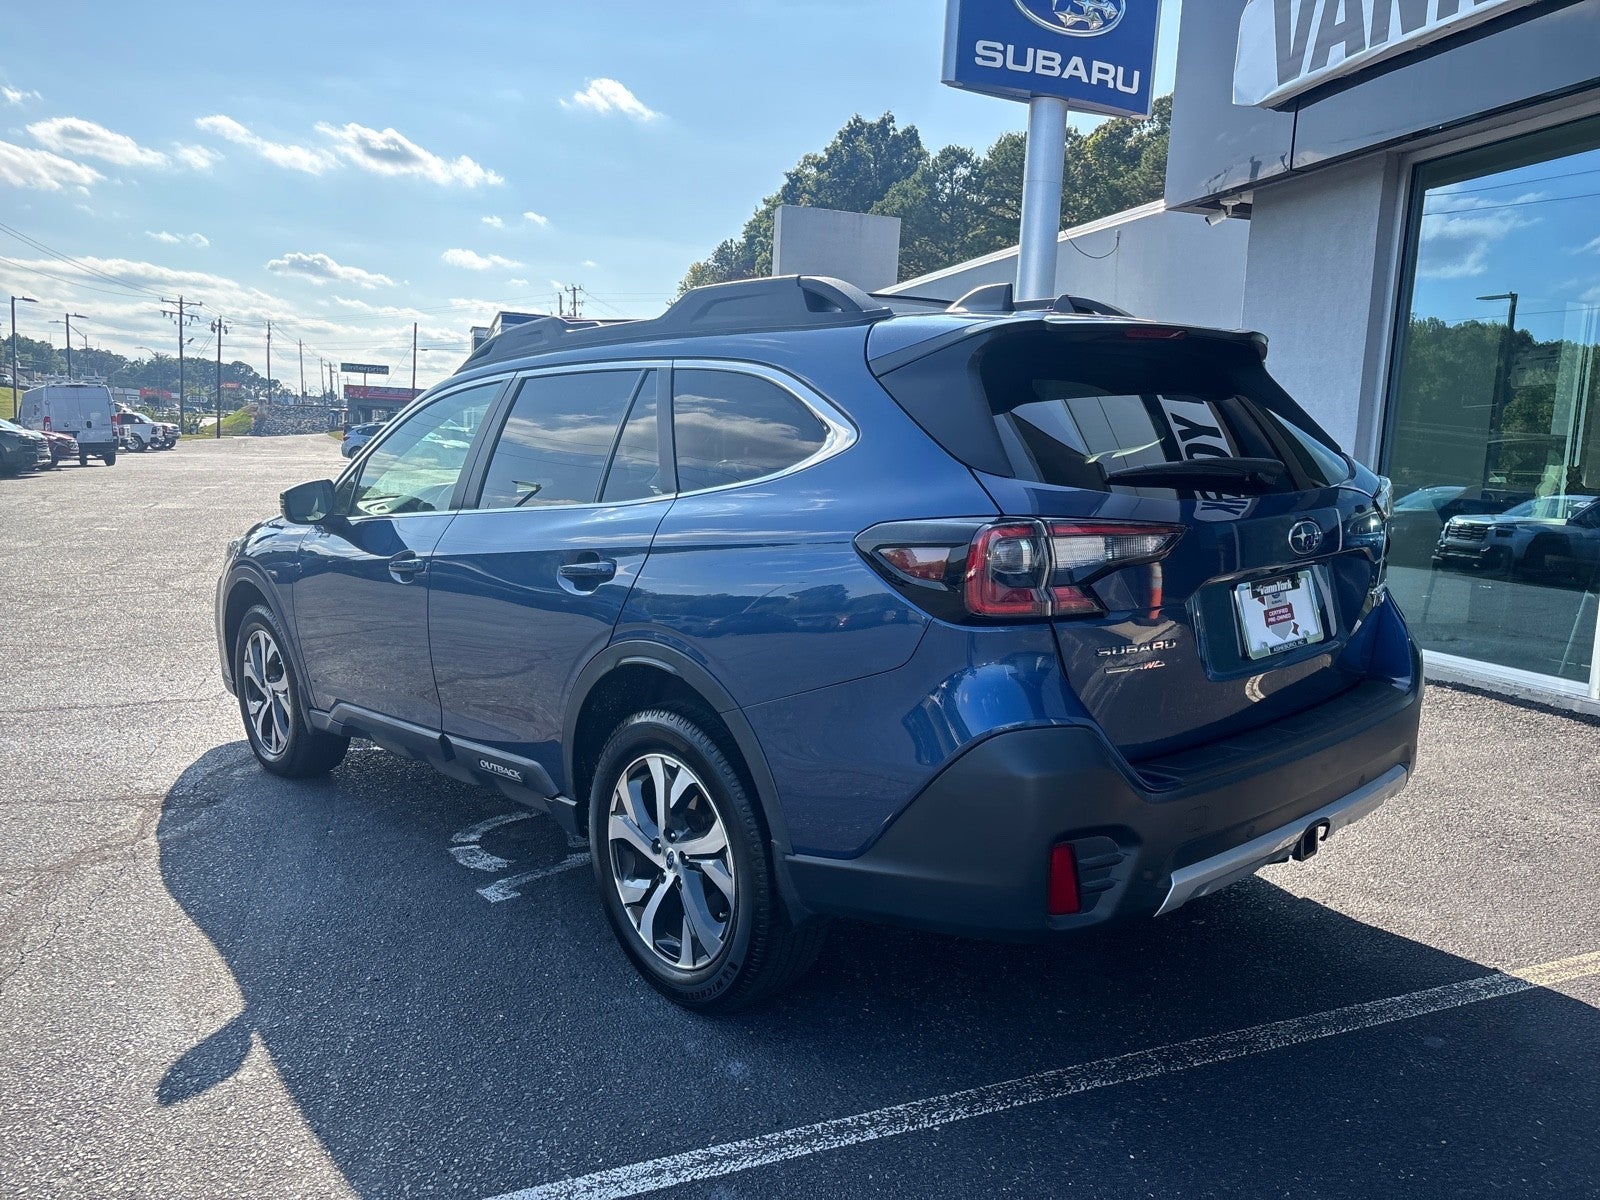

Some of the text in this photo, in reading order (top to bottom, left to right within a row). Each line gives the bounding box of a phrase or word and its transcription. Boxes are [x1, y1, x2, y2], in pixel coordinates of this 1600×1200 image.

[975, 39, 1140, 95] SUBARU
[1096, 639, 1176, 657] SUBARU
[480, 759, 521, 780] OUTBACK
